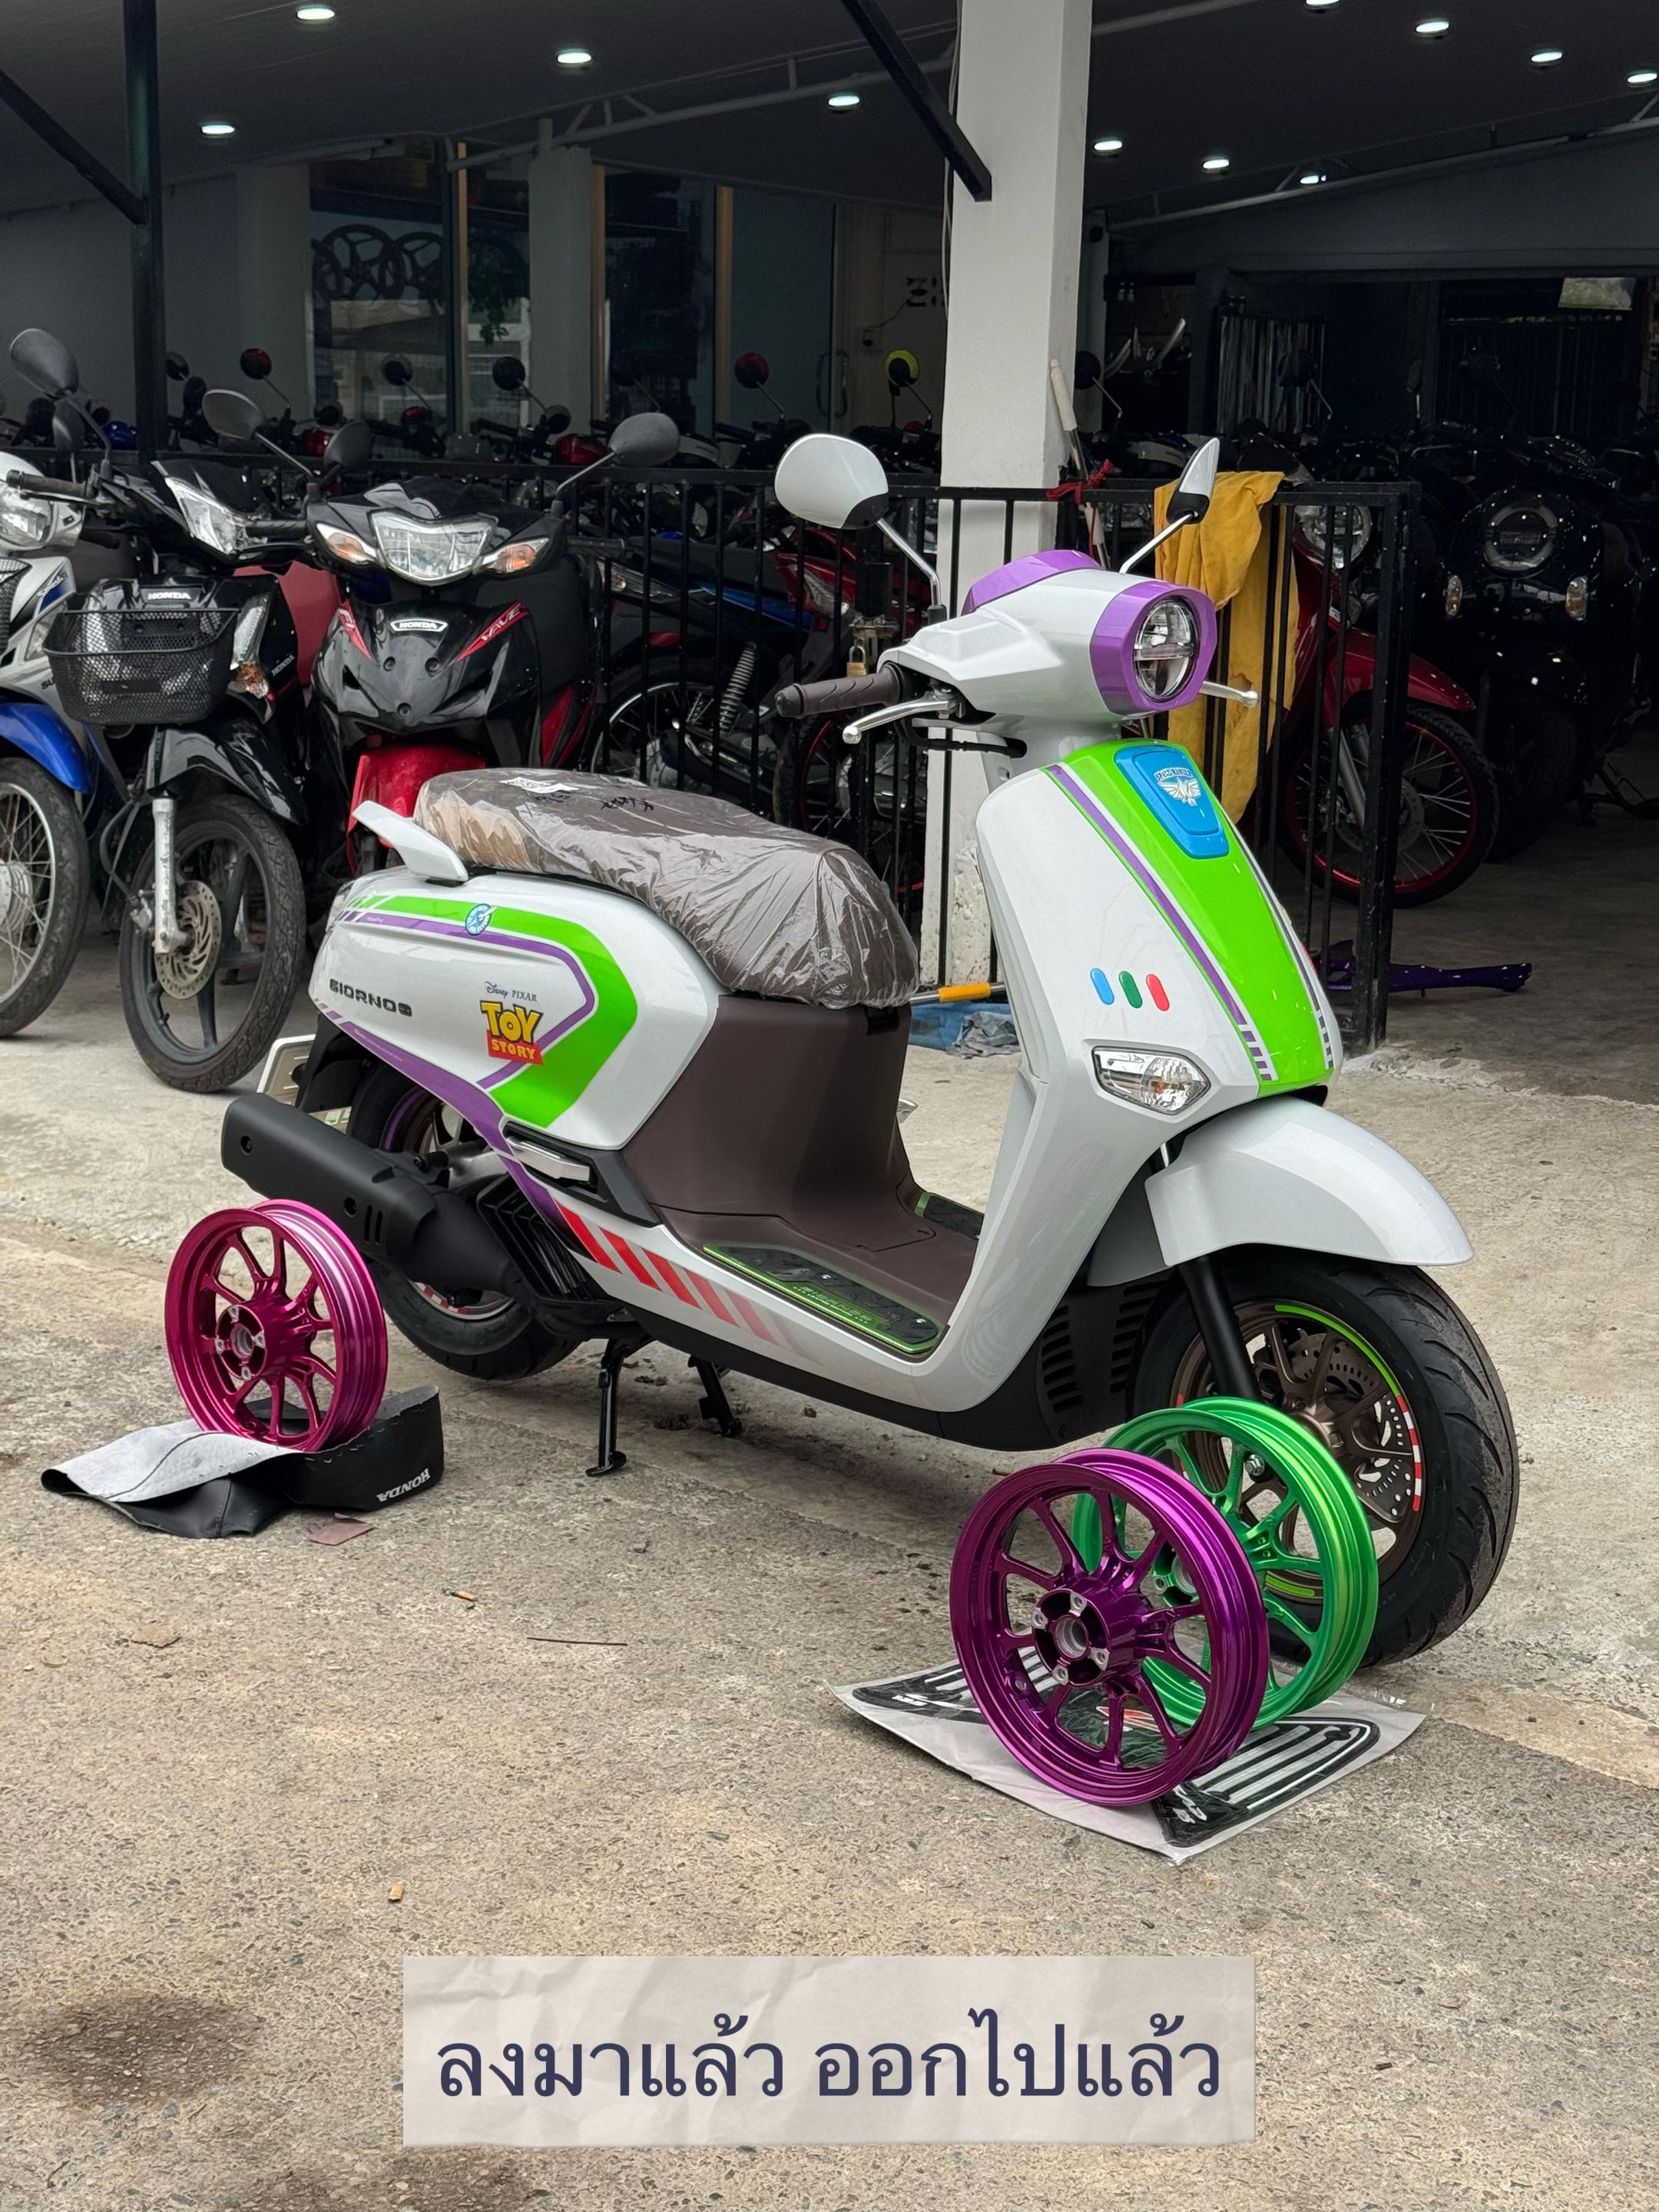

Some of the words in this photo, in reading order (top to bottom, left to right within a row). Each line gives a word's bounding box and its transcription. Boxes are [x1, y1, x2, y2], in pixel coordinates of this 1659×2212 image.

[147, 591, 192, 601] HONDA
[398, 621, 438, 631] HONDA
[270, 654, 295, 677] HONDA
[485, 980, 508, 999] Disney
[512, 989, 538, 1002] PIXAR
[479, 1000, 544, 1045] TOY
[492, 1038, 536, 1061] STORY
[376, 1468, 431, 1502] HONDA
